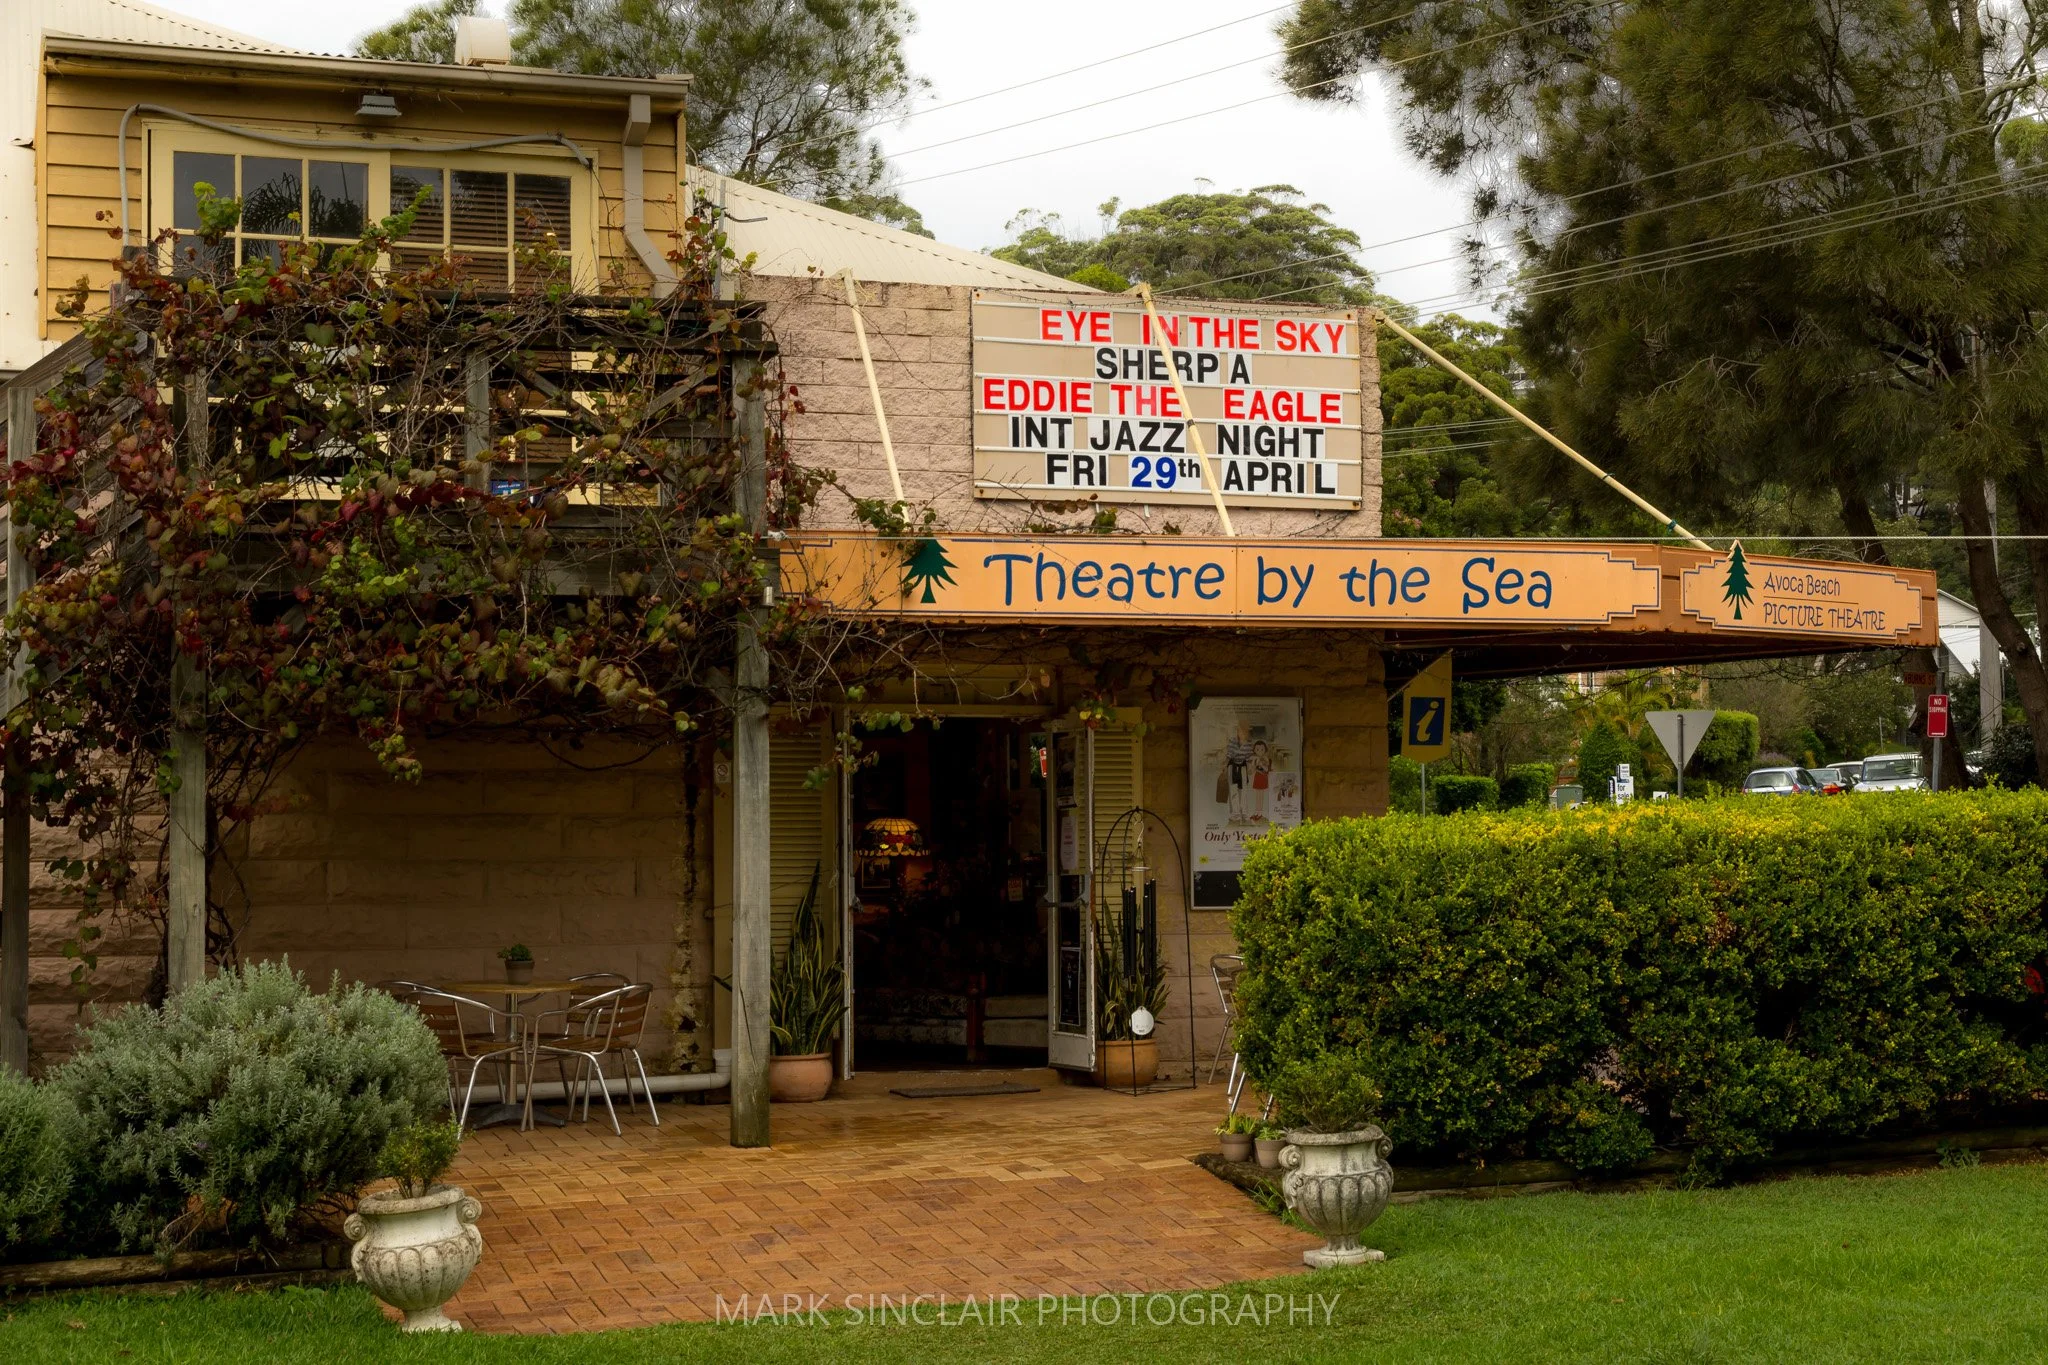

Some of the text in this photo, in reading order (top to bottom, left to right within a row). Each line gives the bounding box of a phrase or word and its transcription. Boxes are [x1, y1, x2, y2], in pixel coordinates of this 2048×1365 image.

[1040, 309, 1345, 354] EYE IN THE SKY
[983, 378, 1342, 424] EDDIE THE EAGLE
[1012, 416, 1324, 459] INT JAZZ NIGHT
[1046, 454, 1336, 495] FRI 29th APRIL
[983, 552, 1552, 614] Theatre by the Sea
[1763, 572, 1841, 596] Avoca Beach
[1763, 602, 1886, 631] PICTURE THEATRE
[1617, 784, 1625, 792] for
[1204, 831, 1231, 844] Only
